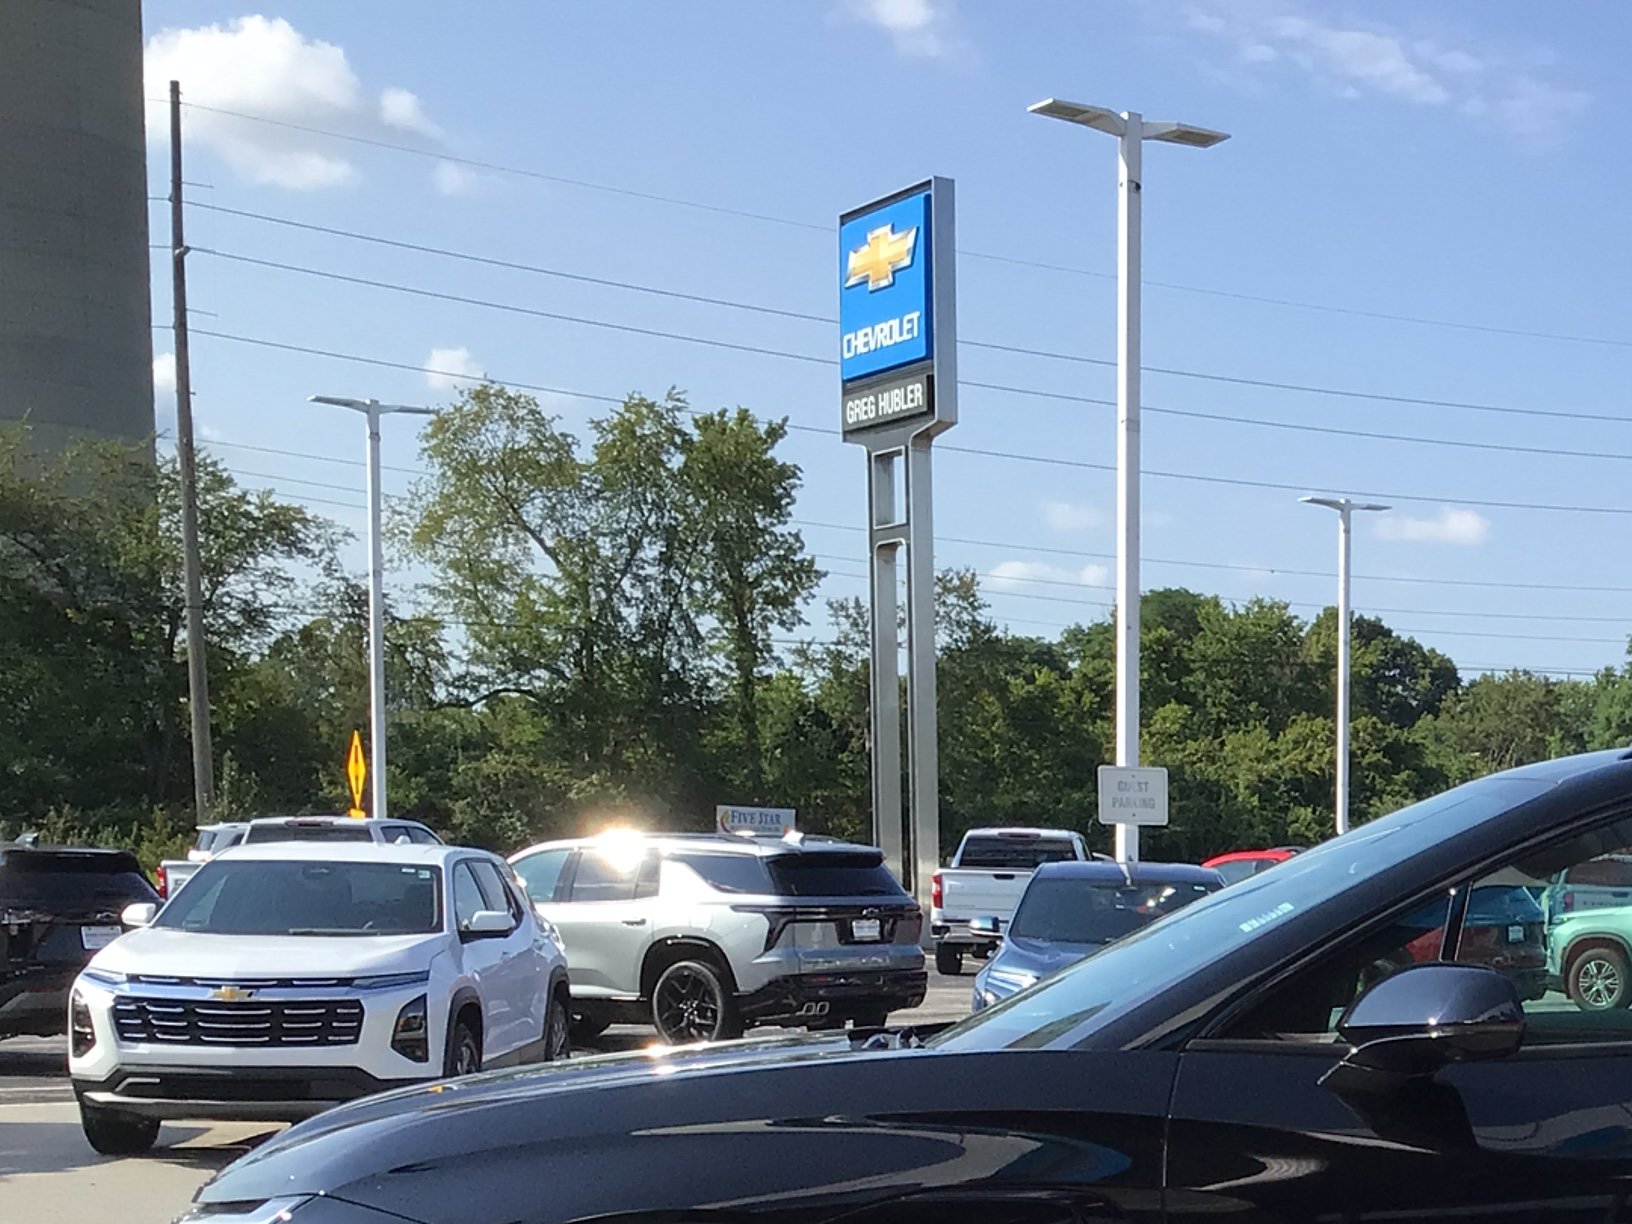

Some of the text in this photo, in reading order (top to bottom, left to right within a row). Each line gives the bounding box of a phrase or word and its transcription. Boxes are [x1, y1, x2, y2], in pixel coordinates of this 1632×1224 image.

[842, 311, 921, 359] CHEVROLET
[846, 383, 922, 424] GREG HUBLER
[1111, 797, 1155, 809] PARKING
[731, 810, 782, 825] FIVE STAR
